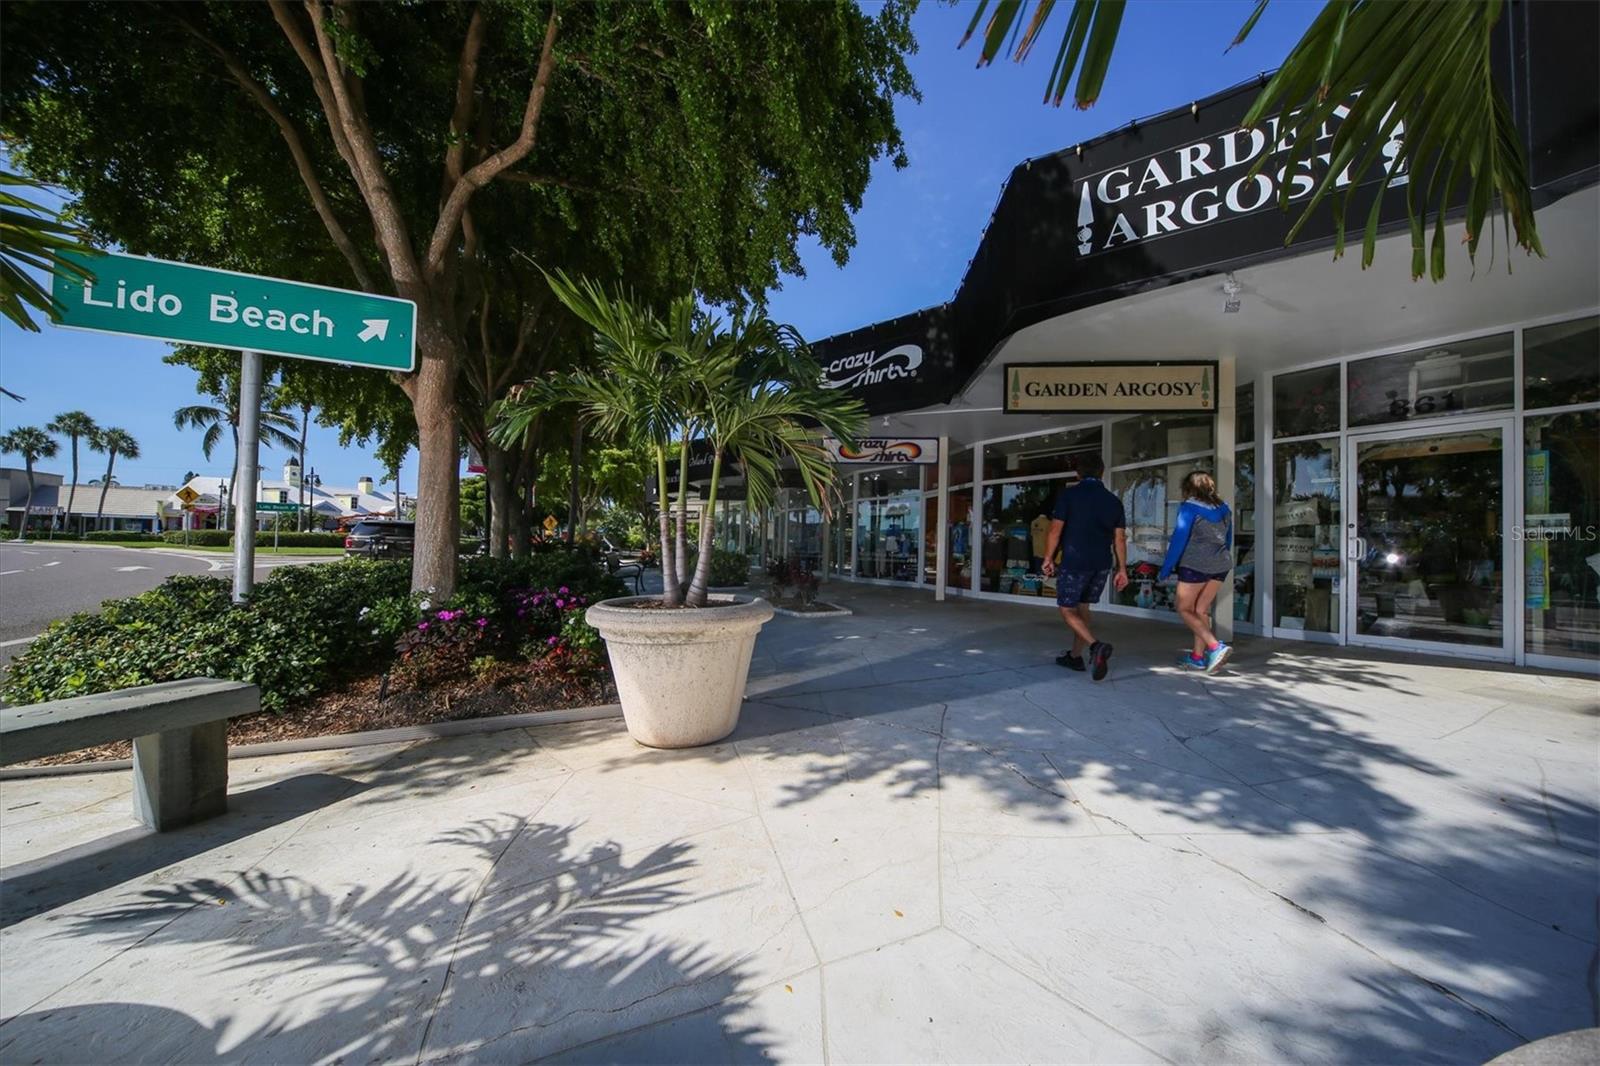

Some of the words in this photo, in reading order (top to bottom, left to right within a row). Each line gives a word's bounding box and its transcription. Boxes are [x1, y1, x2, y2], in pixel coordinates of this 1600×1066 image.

[83, 279, 183, 316] Lido
[209, 293, 335, 337] Beach
[829, 350, 876, 373] crazy
[852, 363, 908, 388] shirts
[1025, 382, 1108, 397] GARDEN
[1113, 381, 1198, 396] ARGOSY
